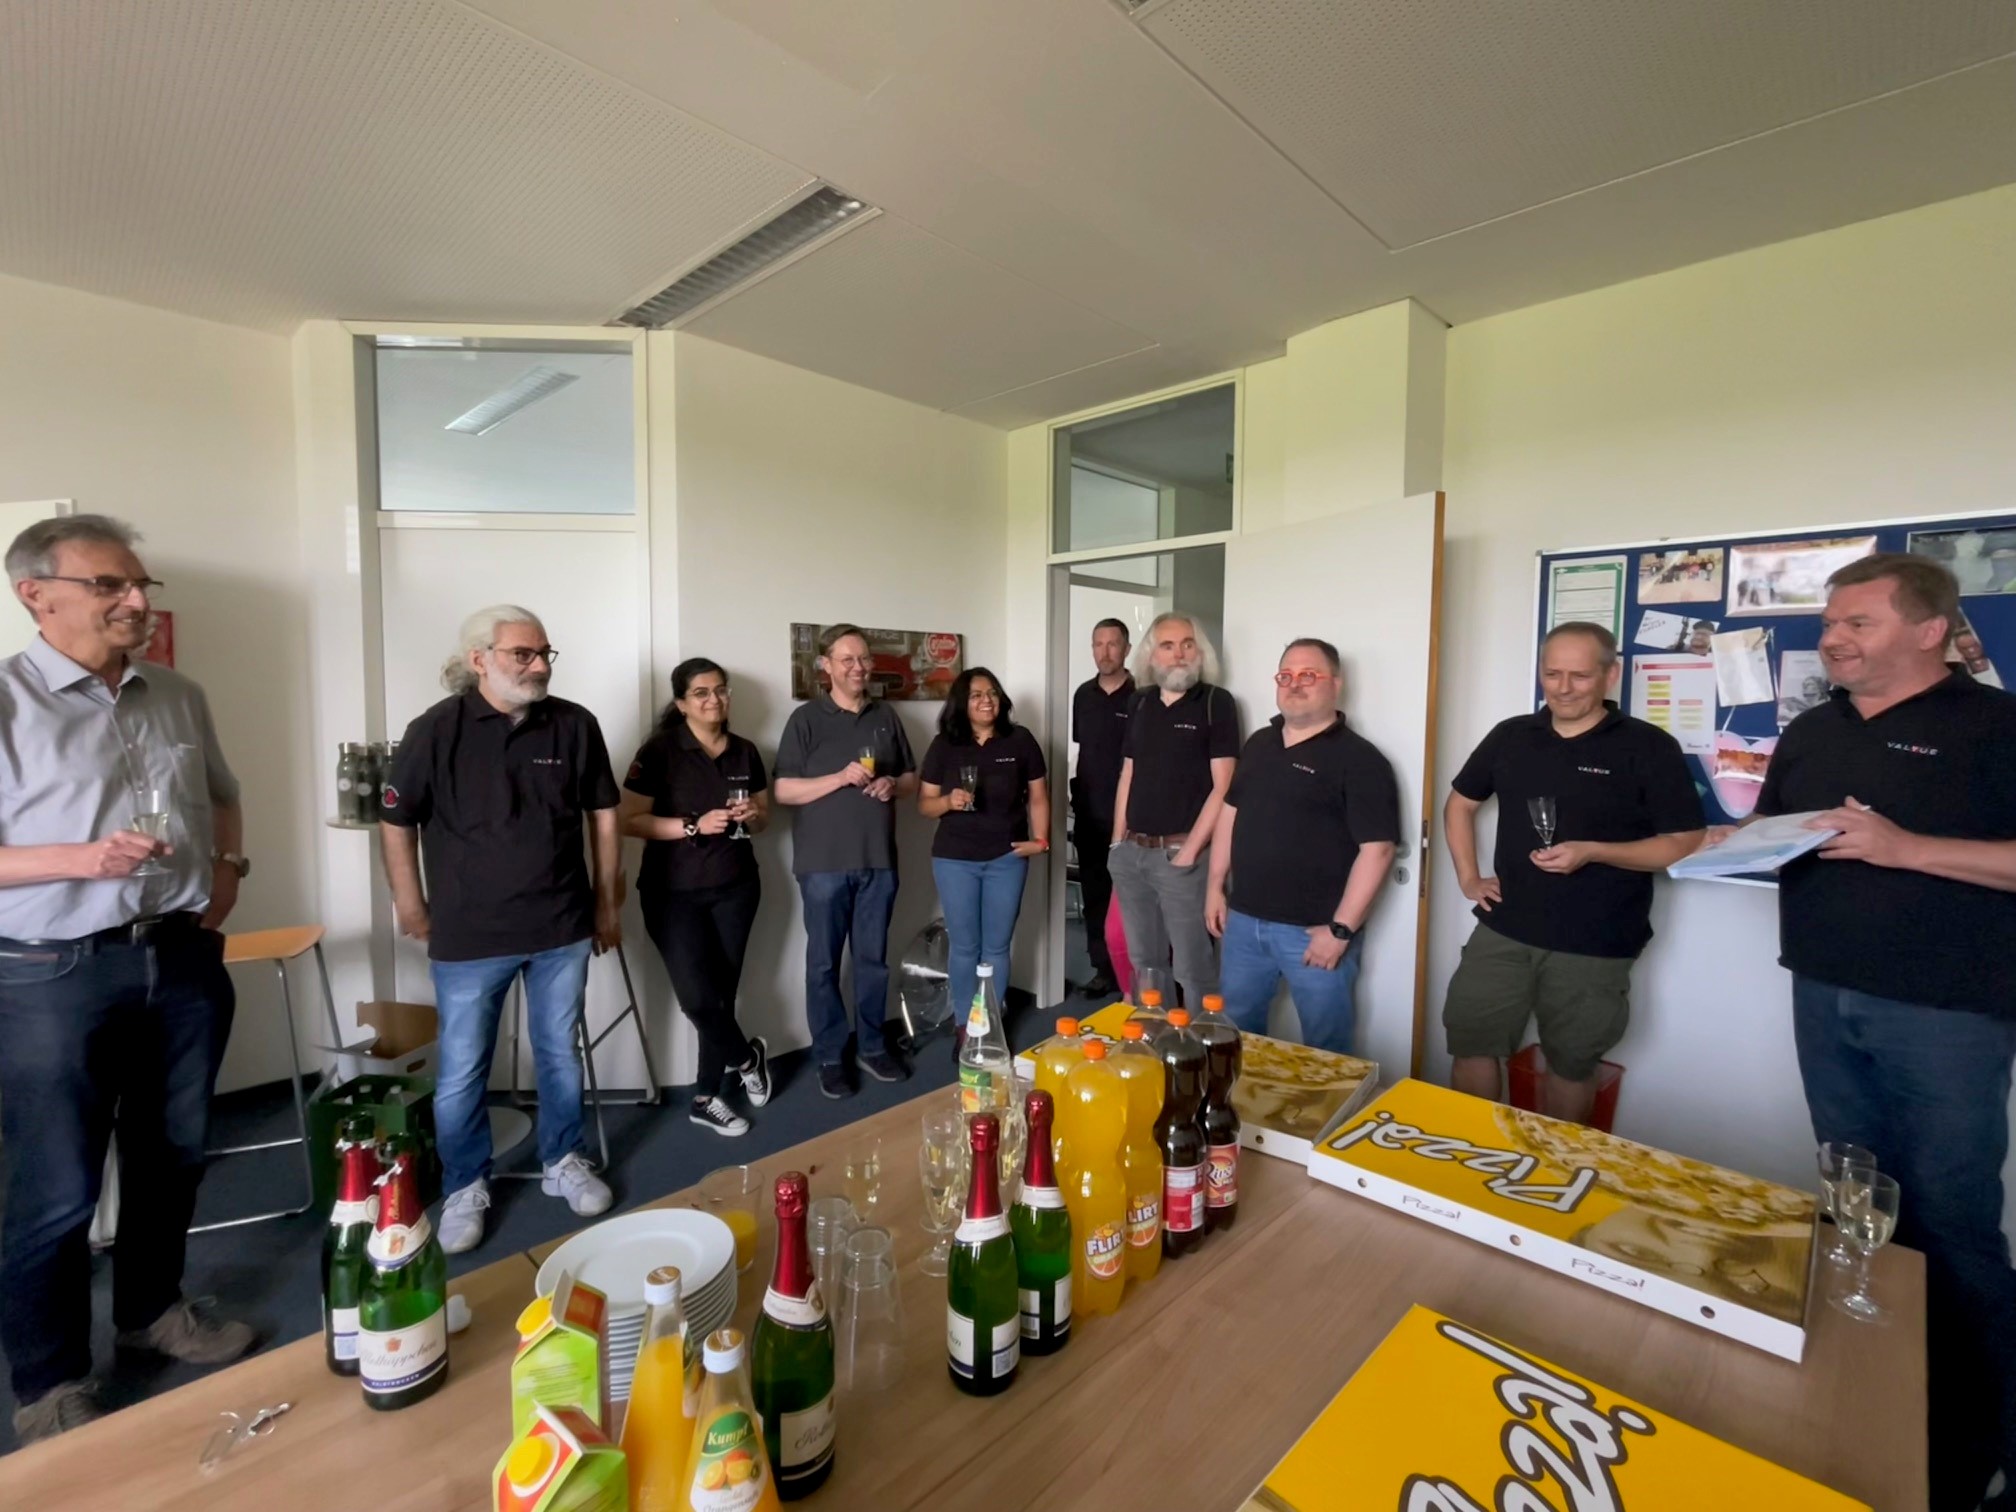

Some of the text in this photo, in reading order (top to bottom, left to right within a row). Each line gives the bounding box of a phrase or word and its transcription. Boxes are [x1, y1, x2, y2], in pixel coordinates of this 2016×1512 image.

[1327, 1110, 1600, 1214] Pizza!
[1127, 1201, 1159, 1223] LIRT
[1402, 1194, 1462, 1222] Pizza!
[1570, 1257, 1646, 1292] Pizza!
